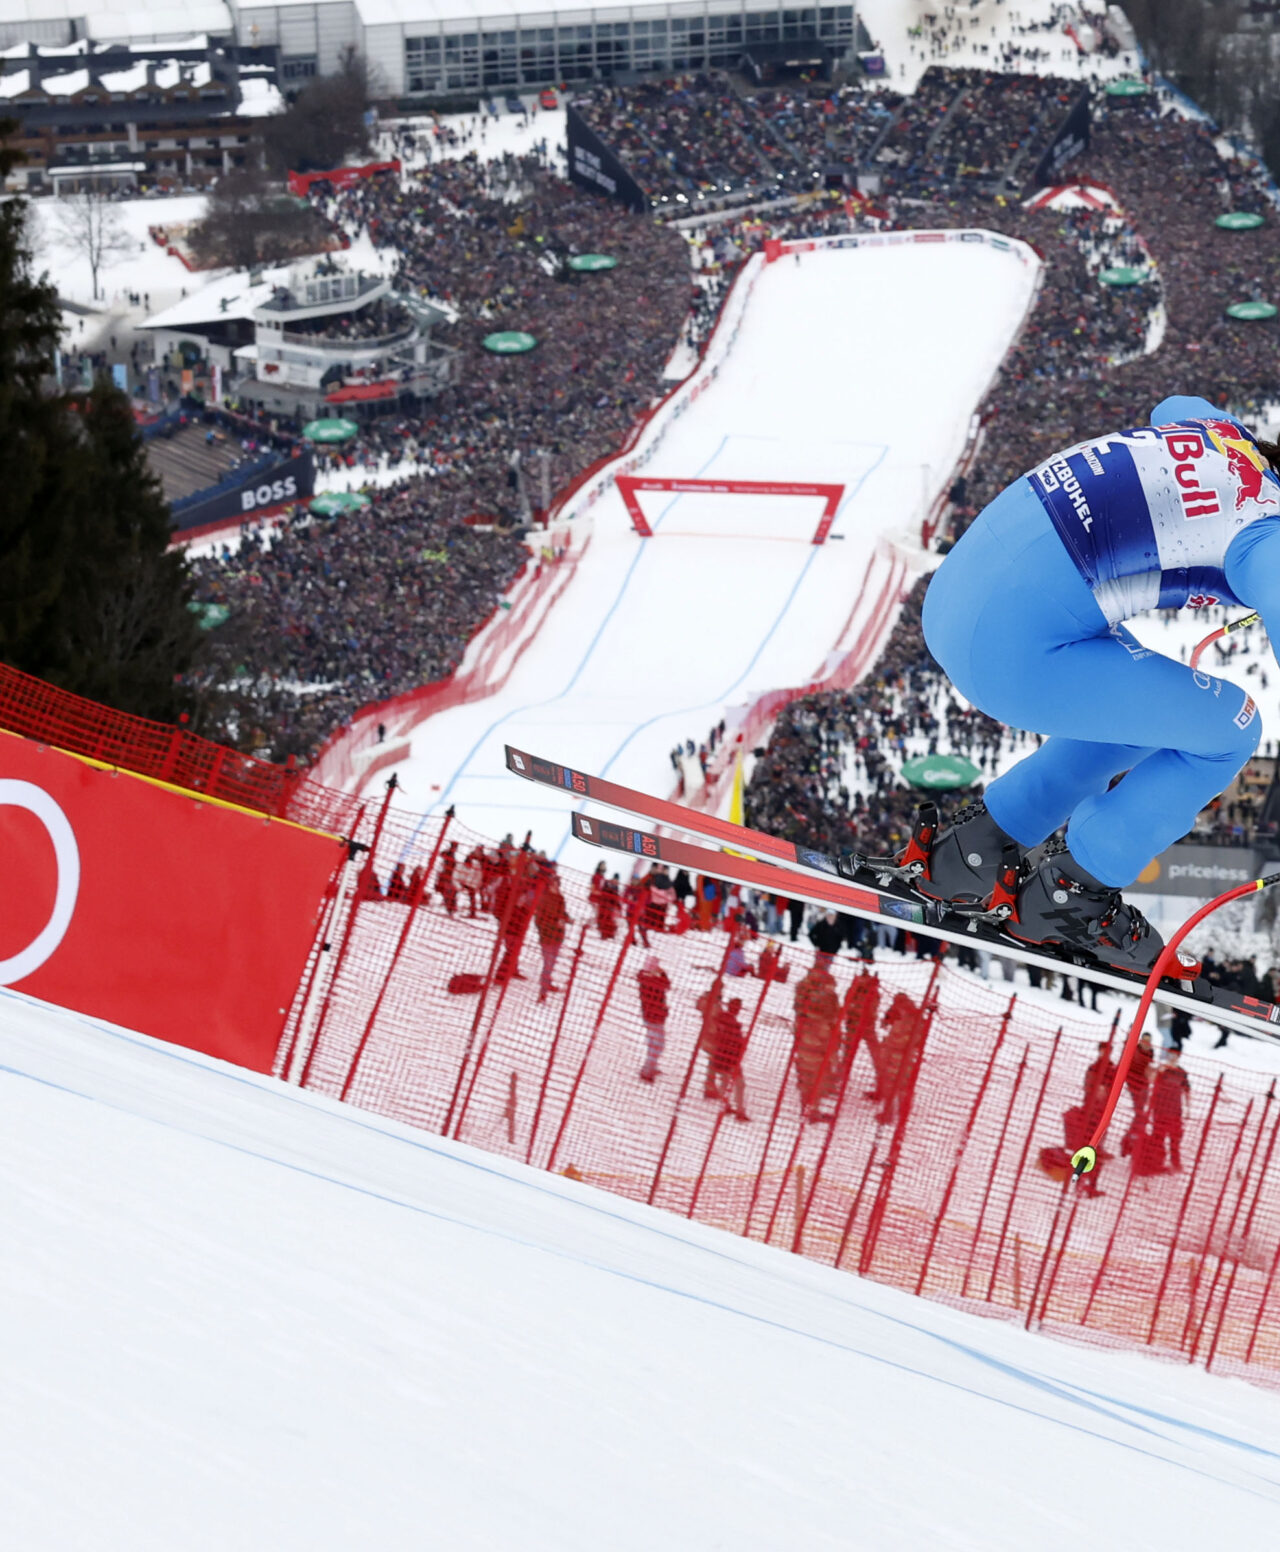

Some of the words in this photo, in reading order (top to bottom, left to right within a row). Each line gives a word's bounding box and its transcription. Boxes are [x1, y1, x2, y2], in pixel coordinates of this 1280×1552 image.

[241, 476, 297, 511] BOSS
[1164, 434, 1221, 519] Bull
[1168, 863, 1249, 881] priceless
